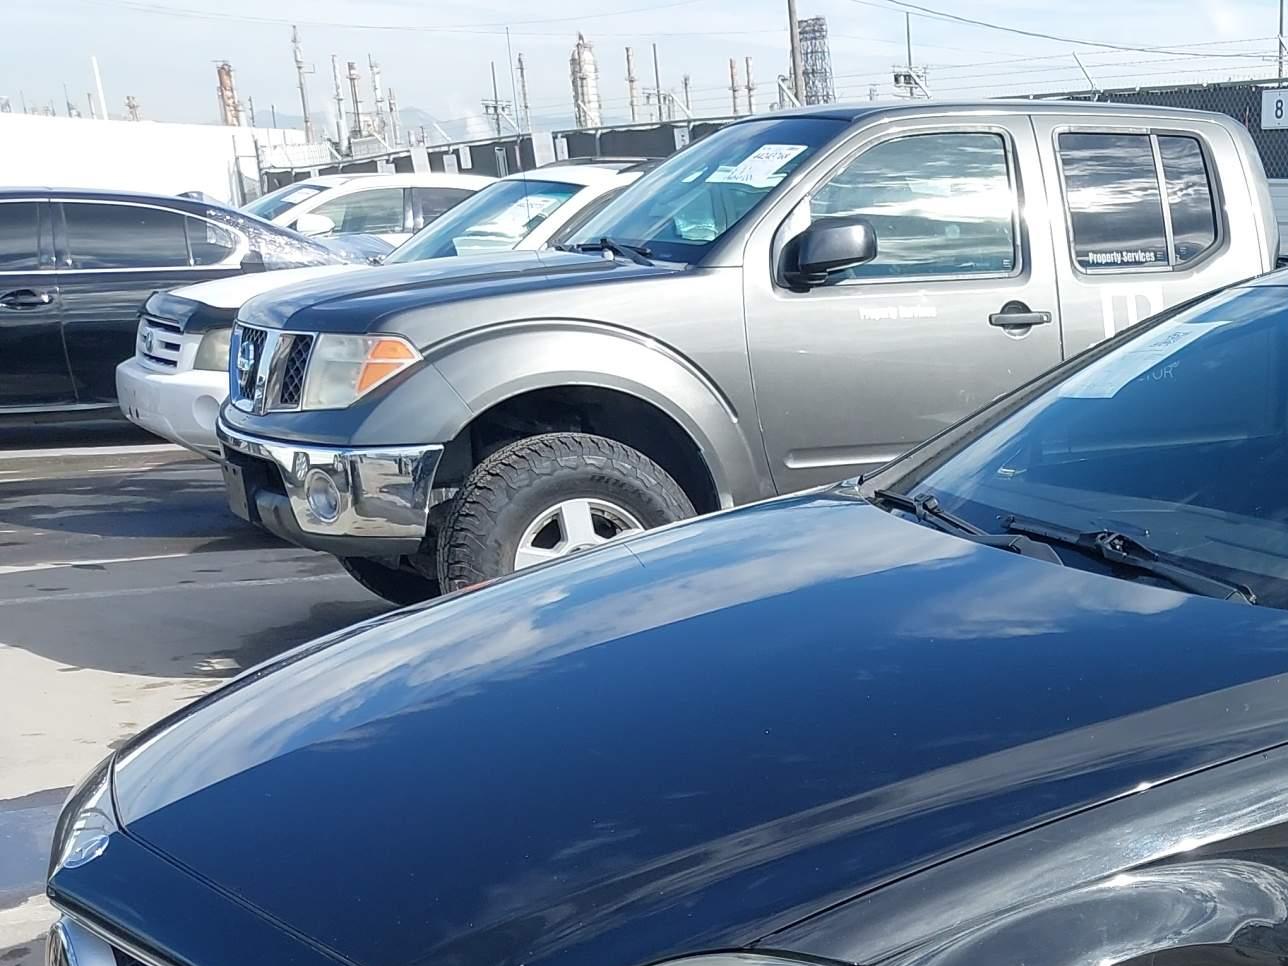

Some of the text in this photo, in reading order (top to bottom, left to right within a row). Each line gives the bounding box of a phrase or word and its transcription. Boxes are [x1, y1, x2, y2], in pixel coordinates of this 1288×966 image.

[1275, 99, 1284, 119] 8
[1088, 249, 1156, 264] Property Services
